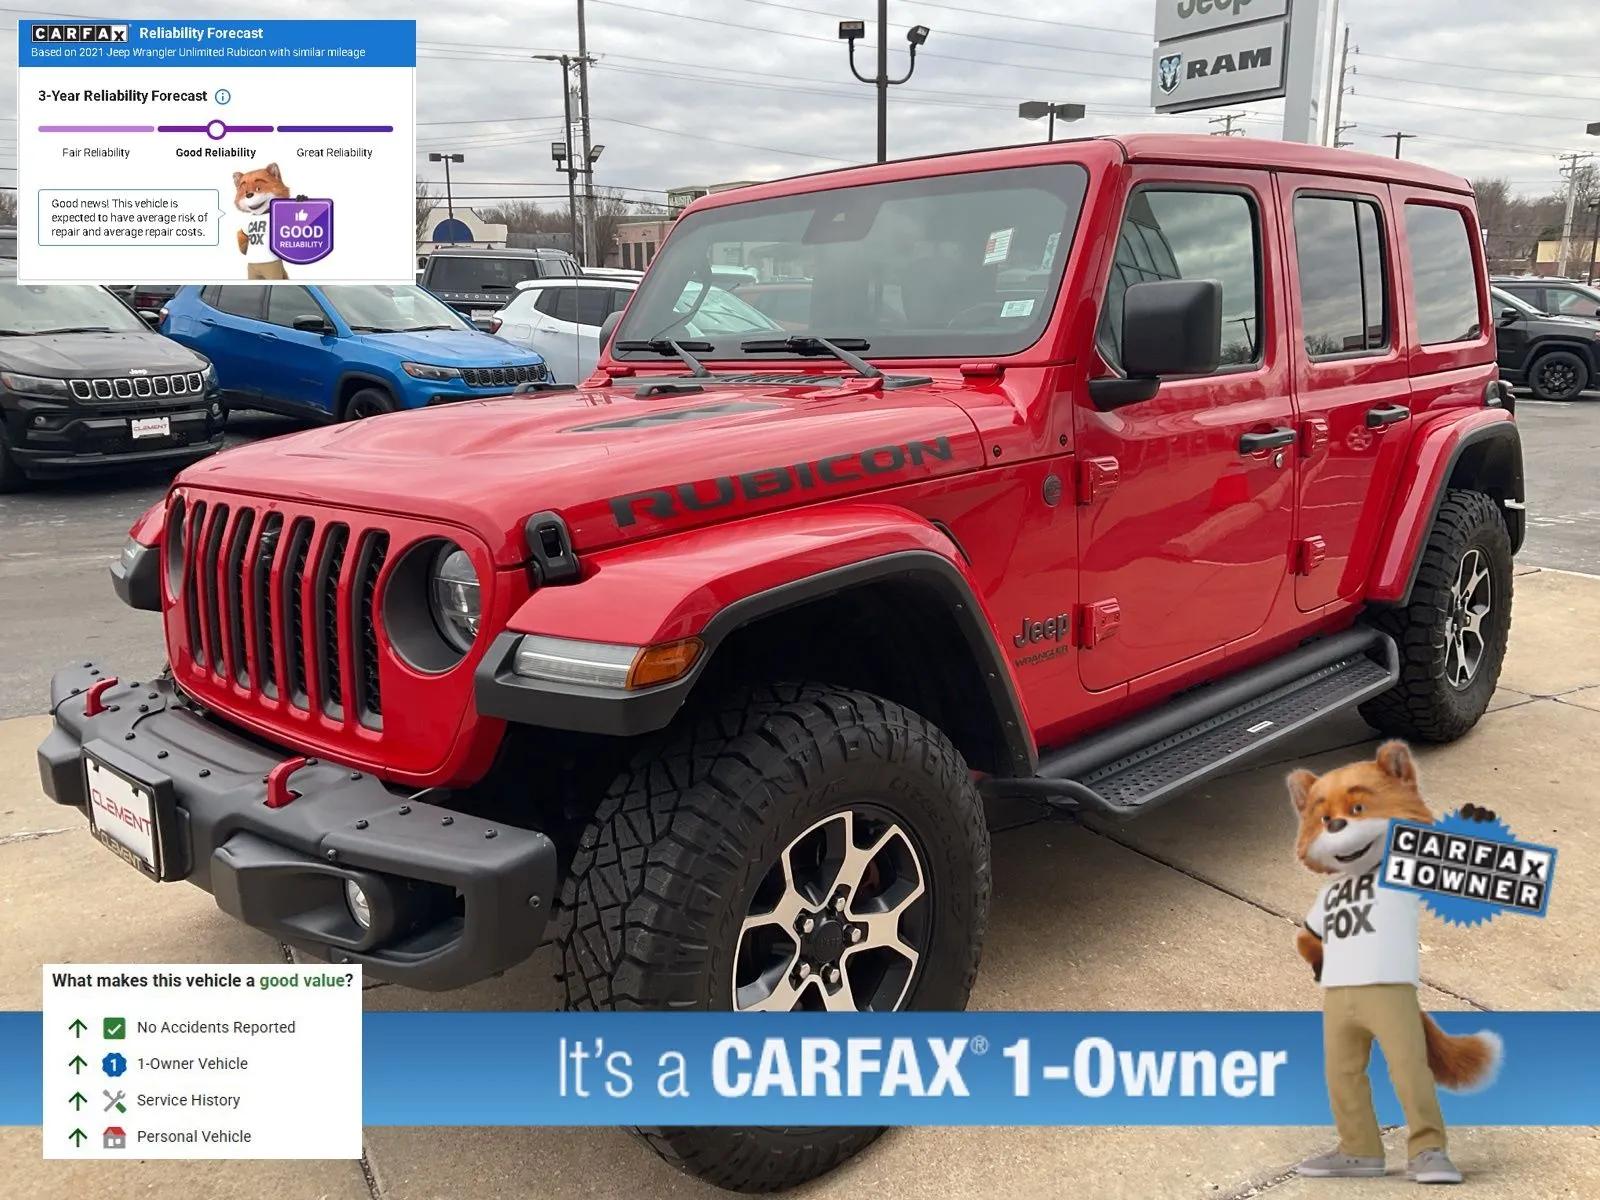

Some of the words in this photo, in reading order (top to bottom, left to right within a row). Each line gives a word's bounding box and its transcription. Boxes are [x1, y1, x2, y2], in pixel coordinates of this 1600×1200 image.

[1186, 46, 1272, 80] RAM
[133, 423, 168, 432] CLEMENT
[609, 435, 954, 528] RUBICON
[1013, 613, 1069, 649] Jeep
[92, 788, 151, 836] CLEMENT
